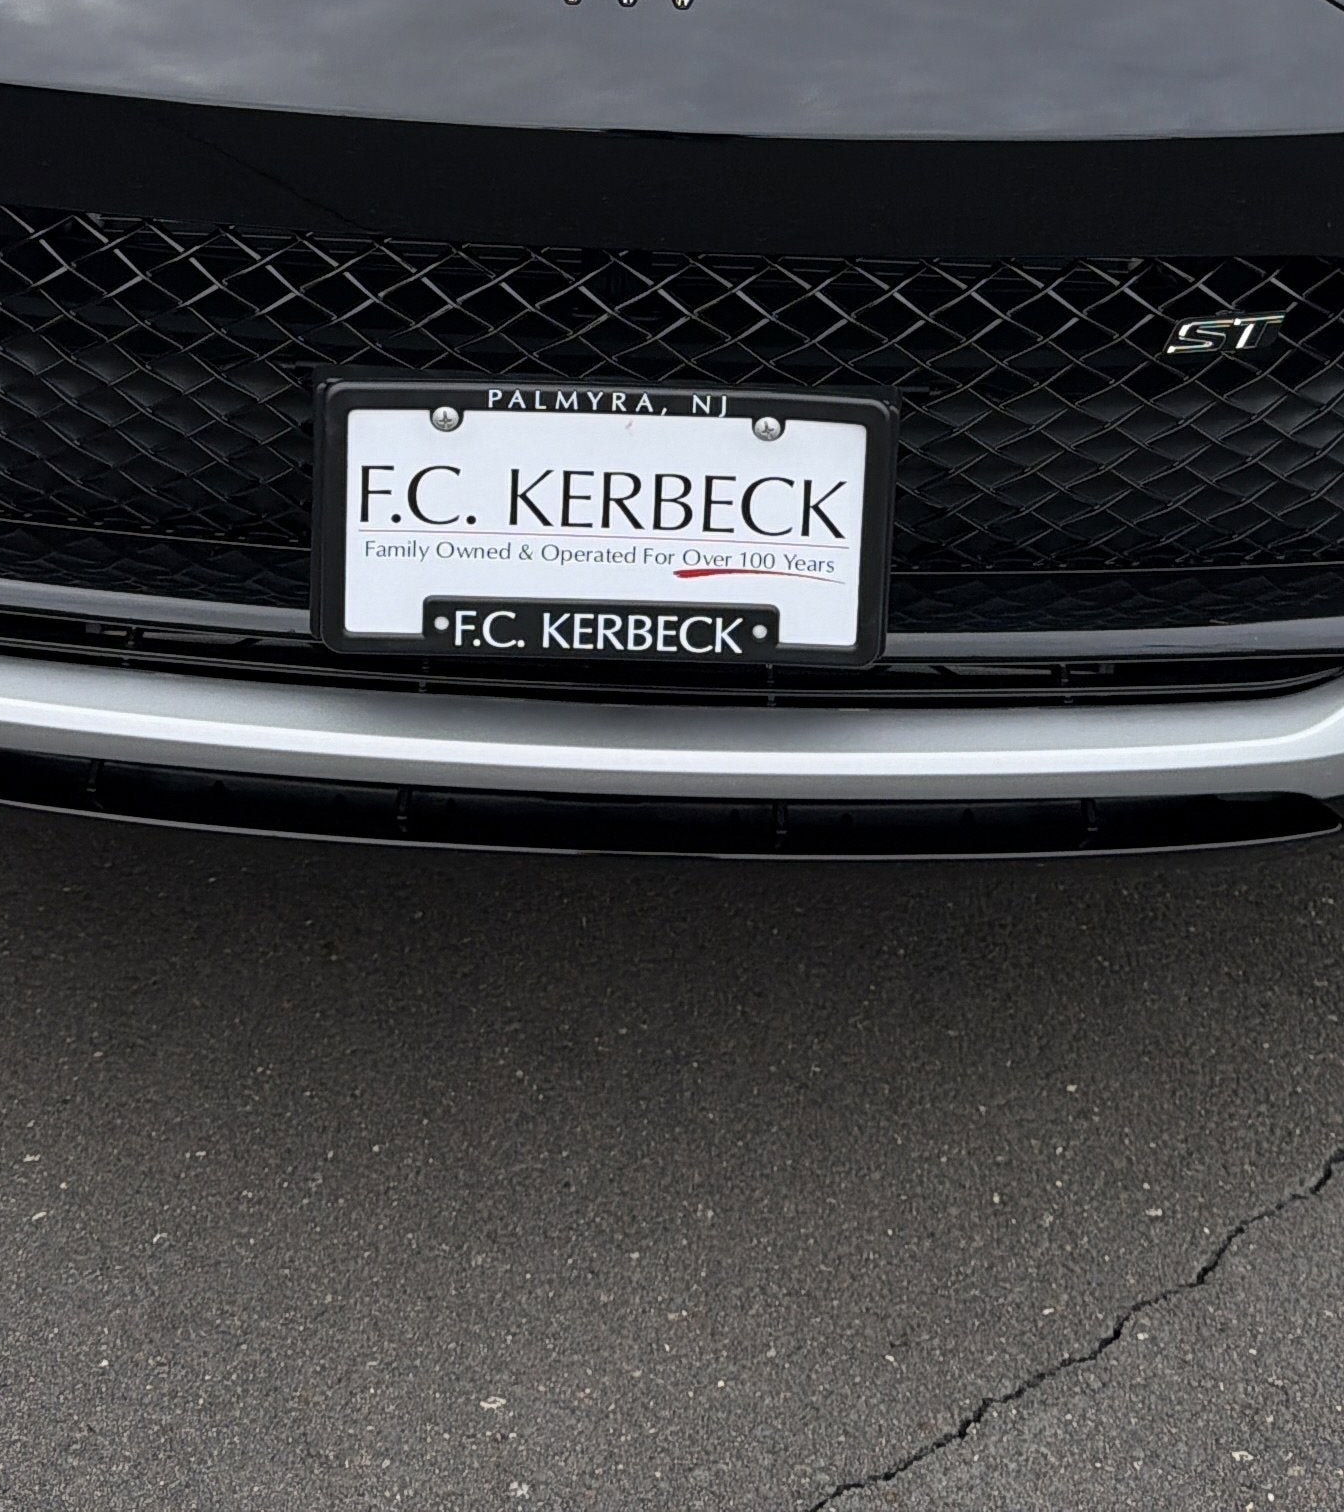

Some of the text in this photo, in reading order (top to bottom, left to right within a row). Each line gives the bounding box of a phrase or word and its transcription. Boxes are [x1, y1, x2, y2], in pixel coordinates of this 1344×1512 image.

[1163, 310, 1287, 354] ST
[487, 388, 728, 418] PALMYRA, NJ
[359, 464, 848, 540] F.C. KERBECK
[364, 540, 836, 574] Family Owned & Operated For Over 100 Years
[453, 609, 744, 655] F.C. KERBECK
